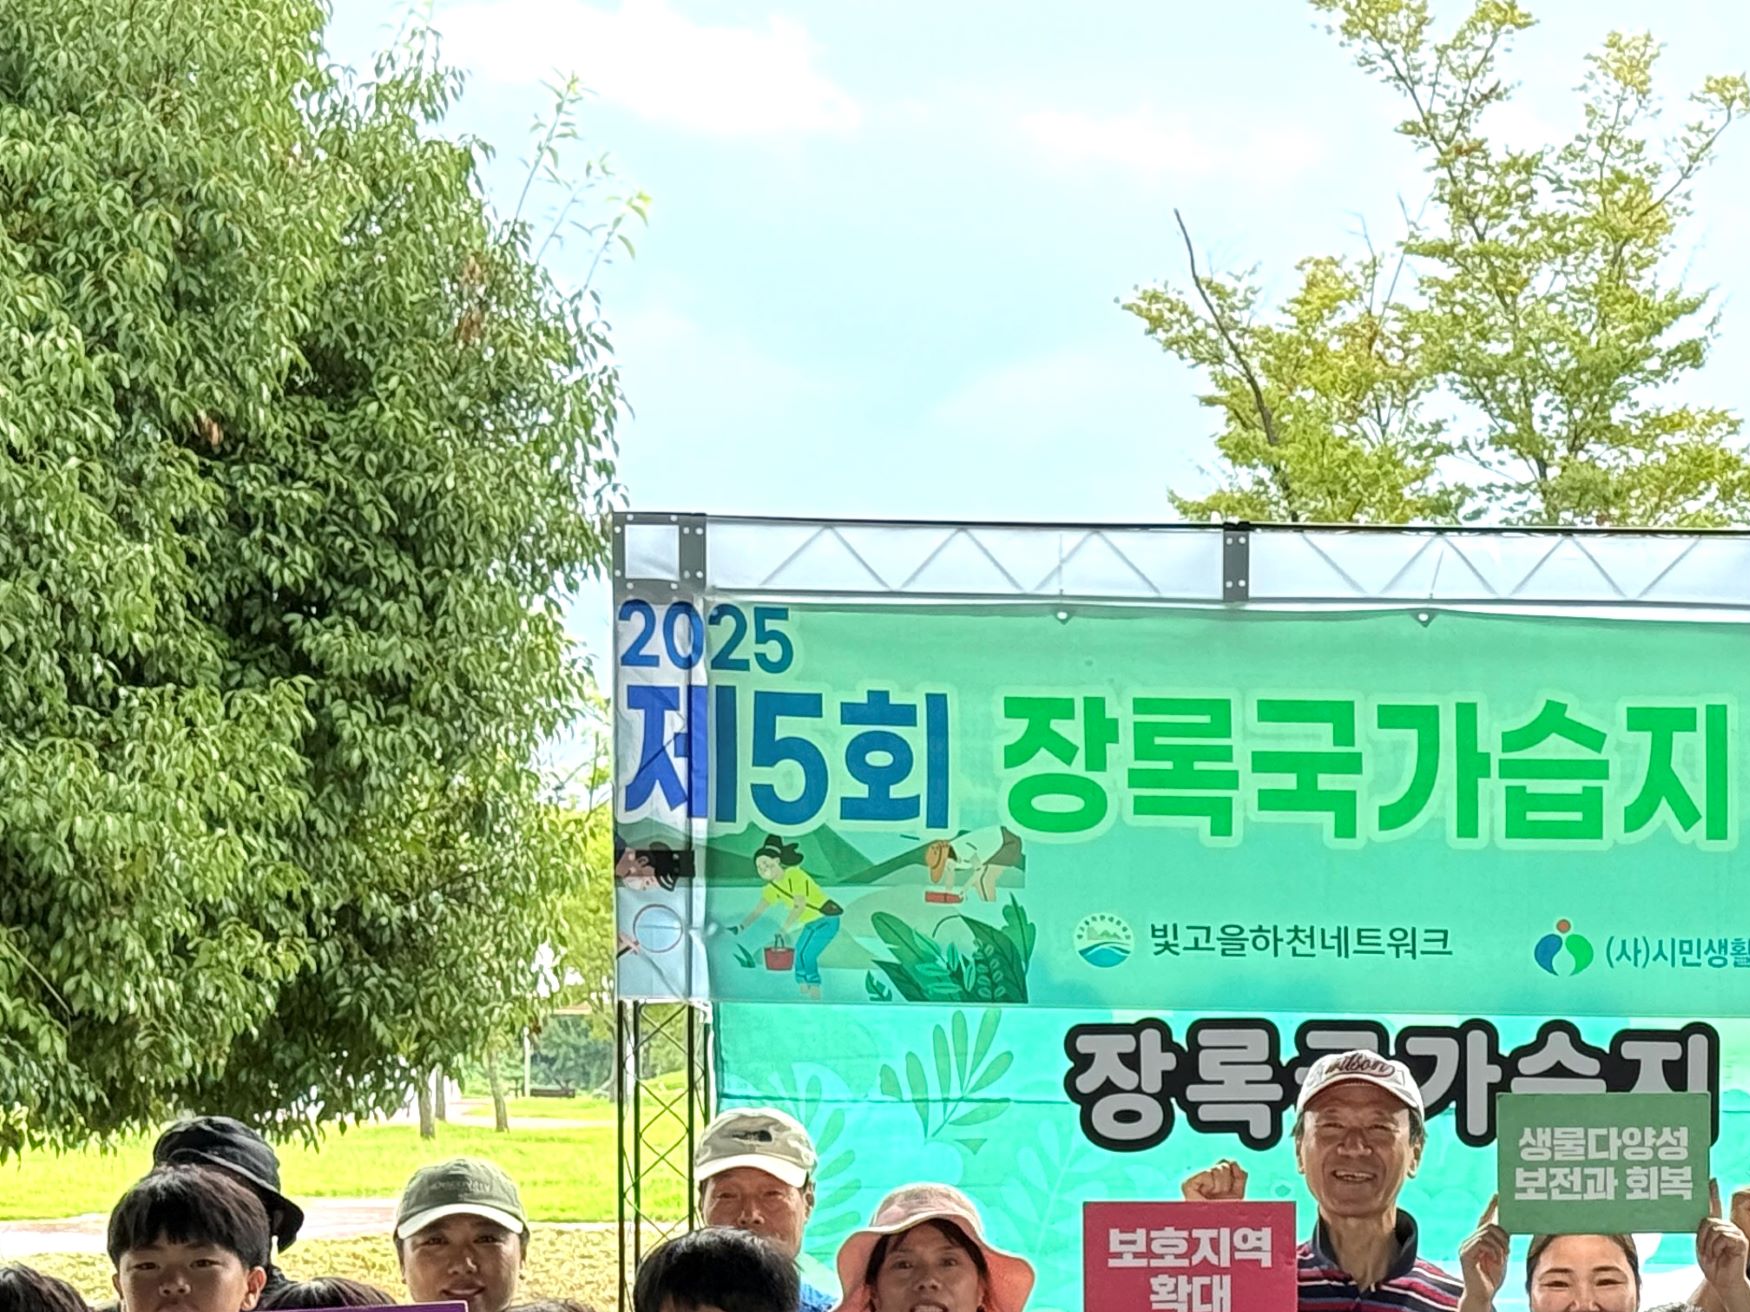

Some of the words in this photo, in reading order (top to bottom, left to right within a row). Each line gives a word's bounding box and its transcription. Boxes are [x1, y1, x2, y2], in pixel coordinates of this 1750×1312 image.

[620, 600, 793, 672] 2025
[625, 684, 950, 830] 제5회
[1003, 696, 1729, 840] 장록국가습지
[1150, 922, 1453, 960] 빛고을하천네트워크
[1519, 1127, 1688, 1161] 생물다양성
[1514, 1166, 1618, 1200] 보전과
[1626, 1166, 1693, 1200] 회복
[1108, 1227, 1272, 1267] 보호지역
